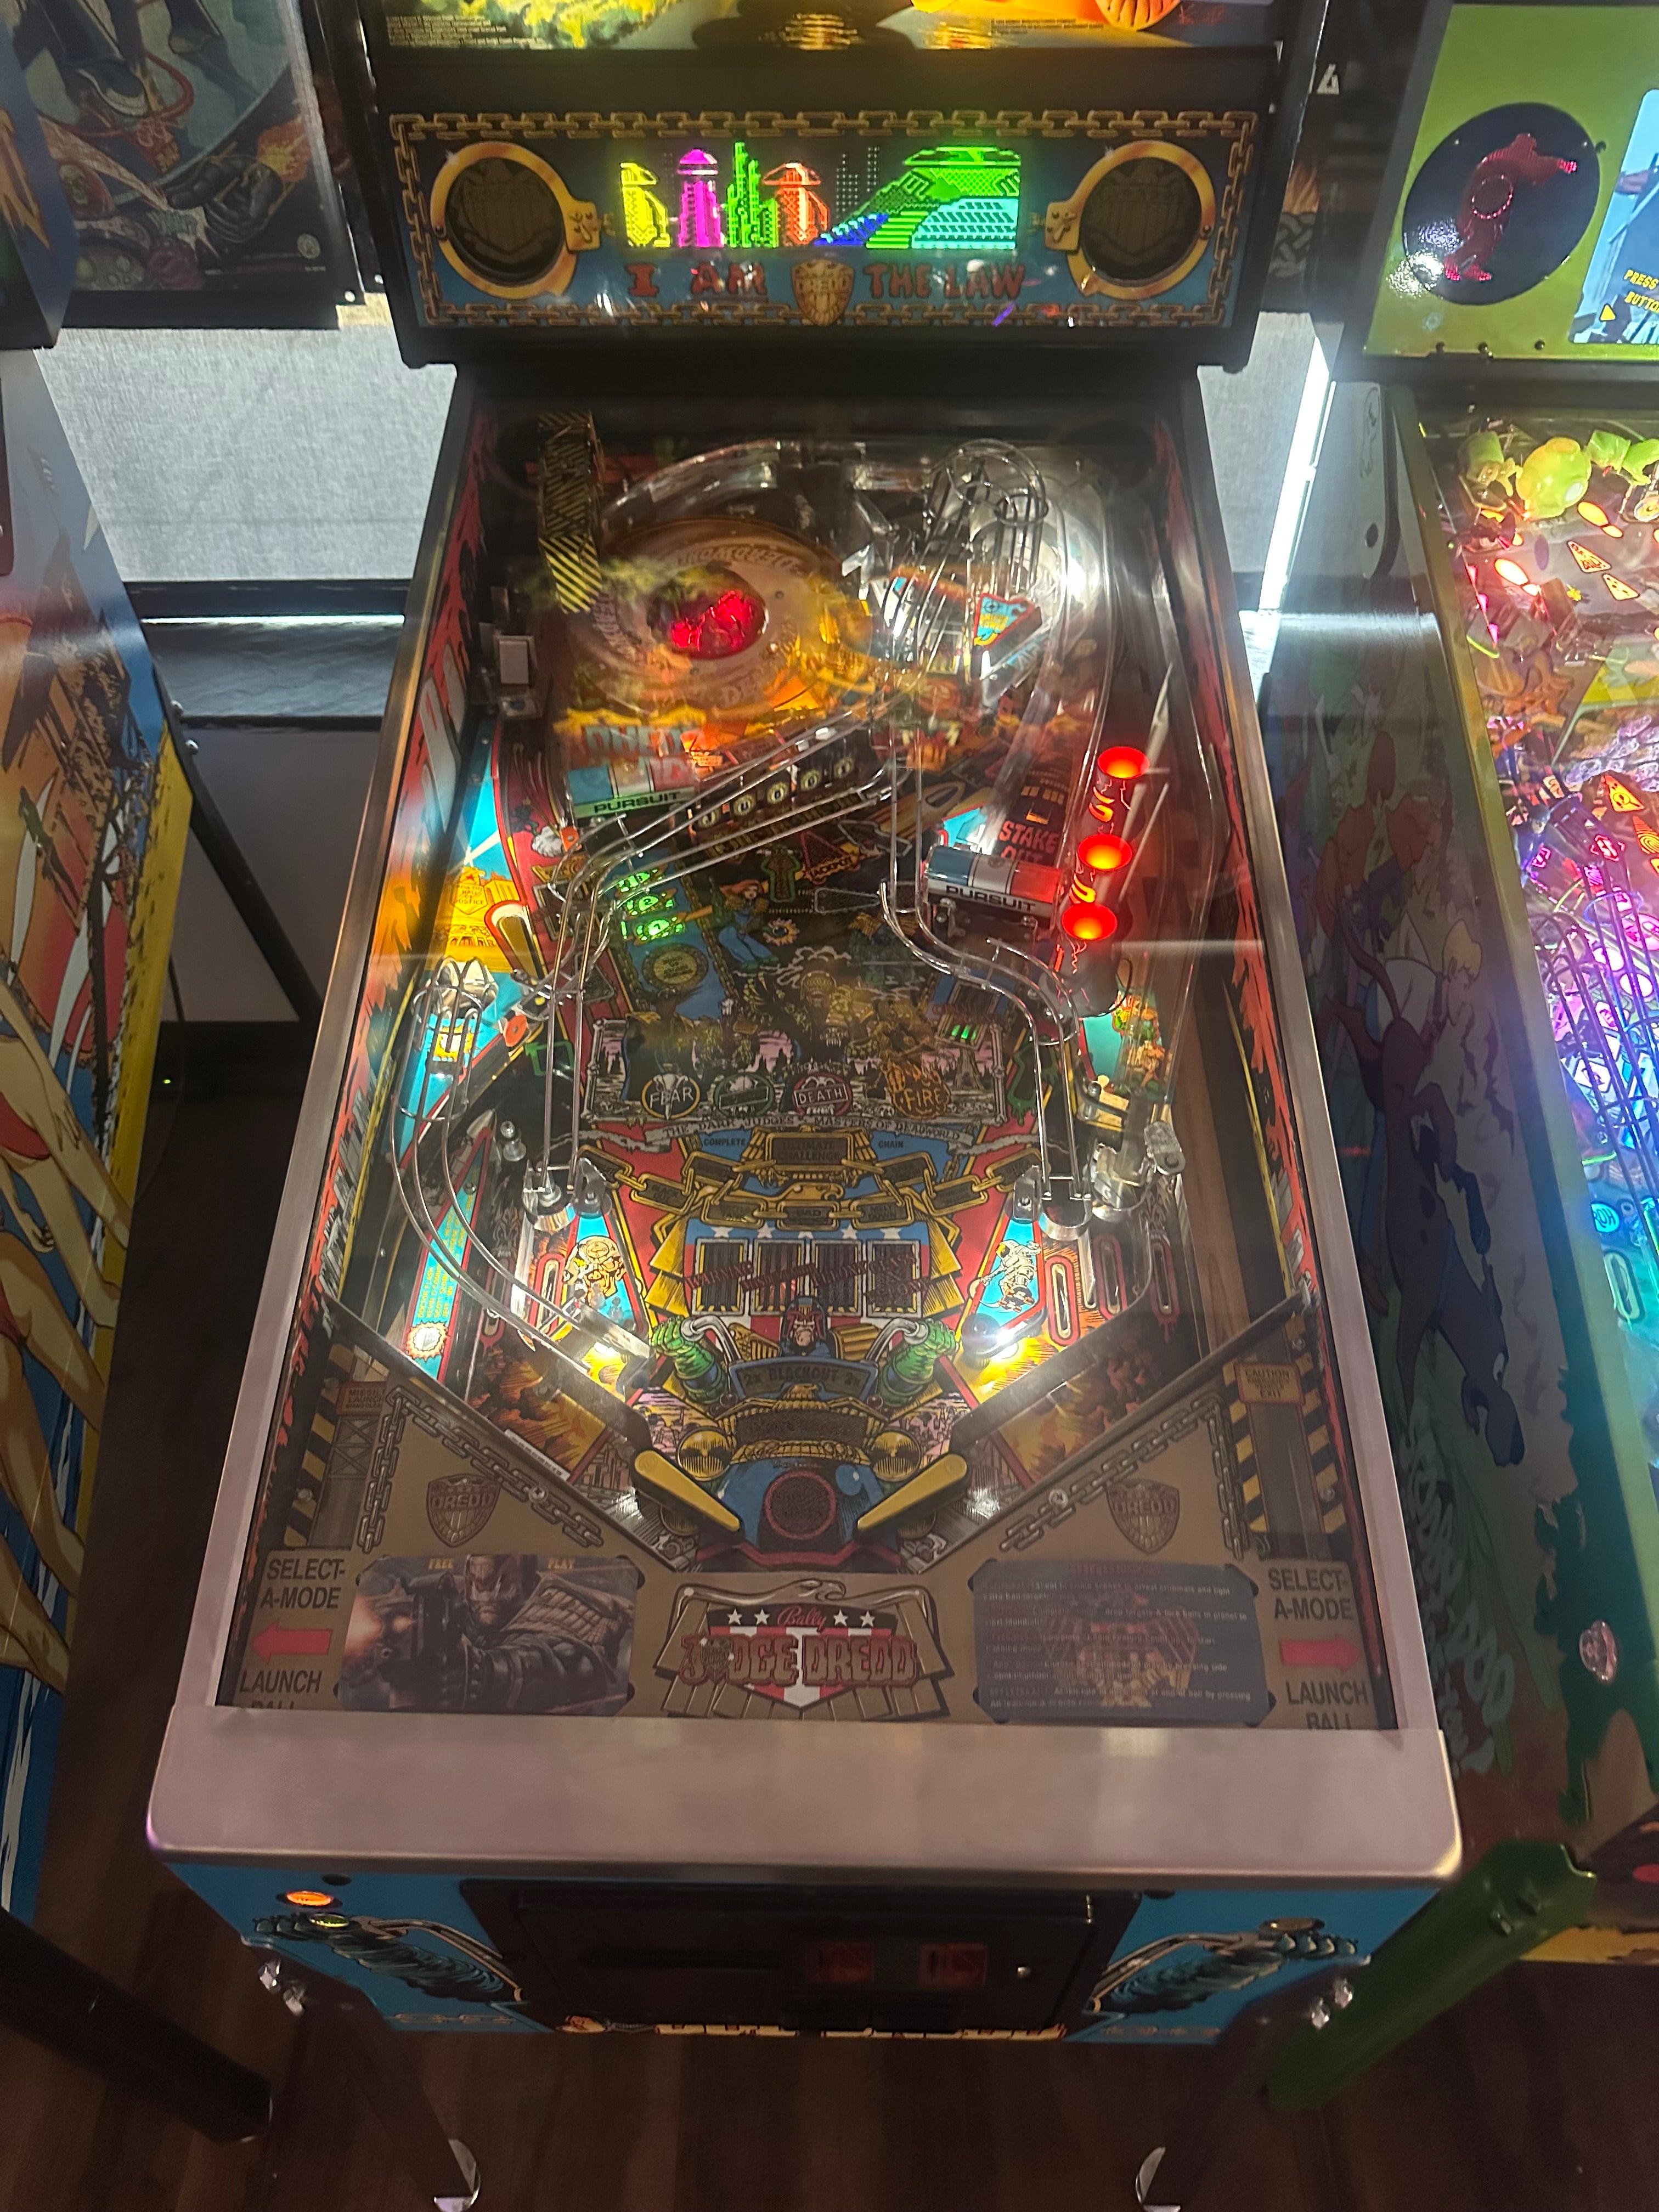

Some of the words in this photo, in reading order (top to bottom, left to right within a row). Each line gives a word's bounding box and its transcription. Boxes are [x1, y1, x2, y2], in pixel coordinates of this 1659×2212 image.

[627, 262, 659, 297] I
[691, 263, 766, 295] AM
[864, 262, 932, 298] THE
[945, 262, 1026, 298] LAW
[1624, 269, 1659, 290] PRESS
[1624, 291, 1659, 314] BUTTO
[594, 791, 681, 814] PURSUIT
[998, 820, 1059, 854] STAKE
[946, 884, 1036, 912] PURSUIT
[799, 1086, 843, 1105] DEATH
[904, 1086, 941, 1111] FIRE
[814, 1116, 878, 1128] MASTERS
[896, 1124, 960, 1141] DEADWORLD
[703, 1137, 747, 1147] COMPLETE
[878, 1140, 904, 1149] CHAIN
[684, 1261, 753, 1289] WARNING
[417, 1291, 428, 1318] DOCTOR
[424, 1267, 433, 1289] FLASH
[434, 1296, 443, 1318] SCOTT
[1245, 1369, 1290, 1378] CAUTION
[432, 1493, 494, 1509] DREDD
[1113, 1499, 1177, 1515] DREDD
[266, 1558, 345, 1581] SELECT-
[428, 1557, 453, 1570] FREE
[548, 1558, 575, 1570] PLAY
[1268, 1566, 1348, 1592] SELECT-
[260, 1587, 341, 1609] A-MODE
[1275, 1597, 1353, 1621] A-MODE
[777, 1605, 827, 1636] Bally
[679, 1633, 799, 1686] JDGE
[802, 1633, 917, 1687] DREDD
[240, 1670, 323, 1694] LAUNCH
[1285, 1680, 1369, 1705] LAUNCH
